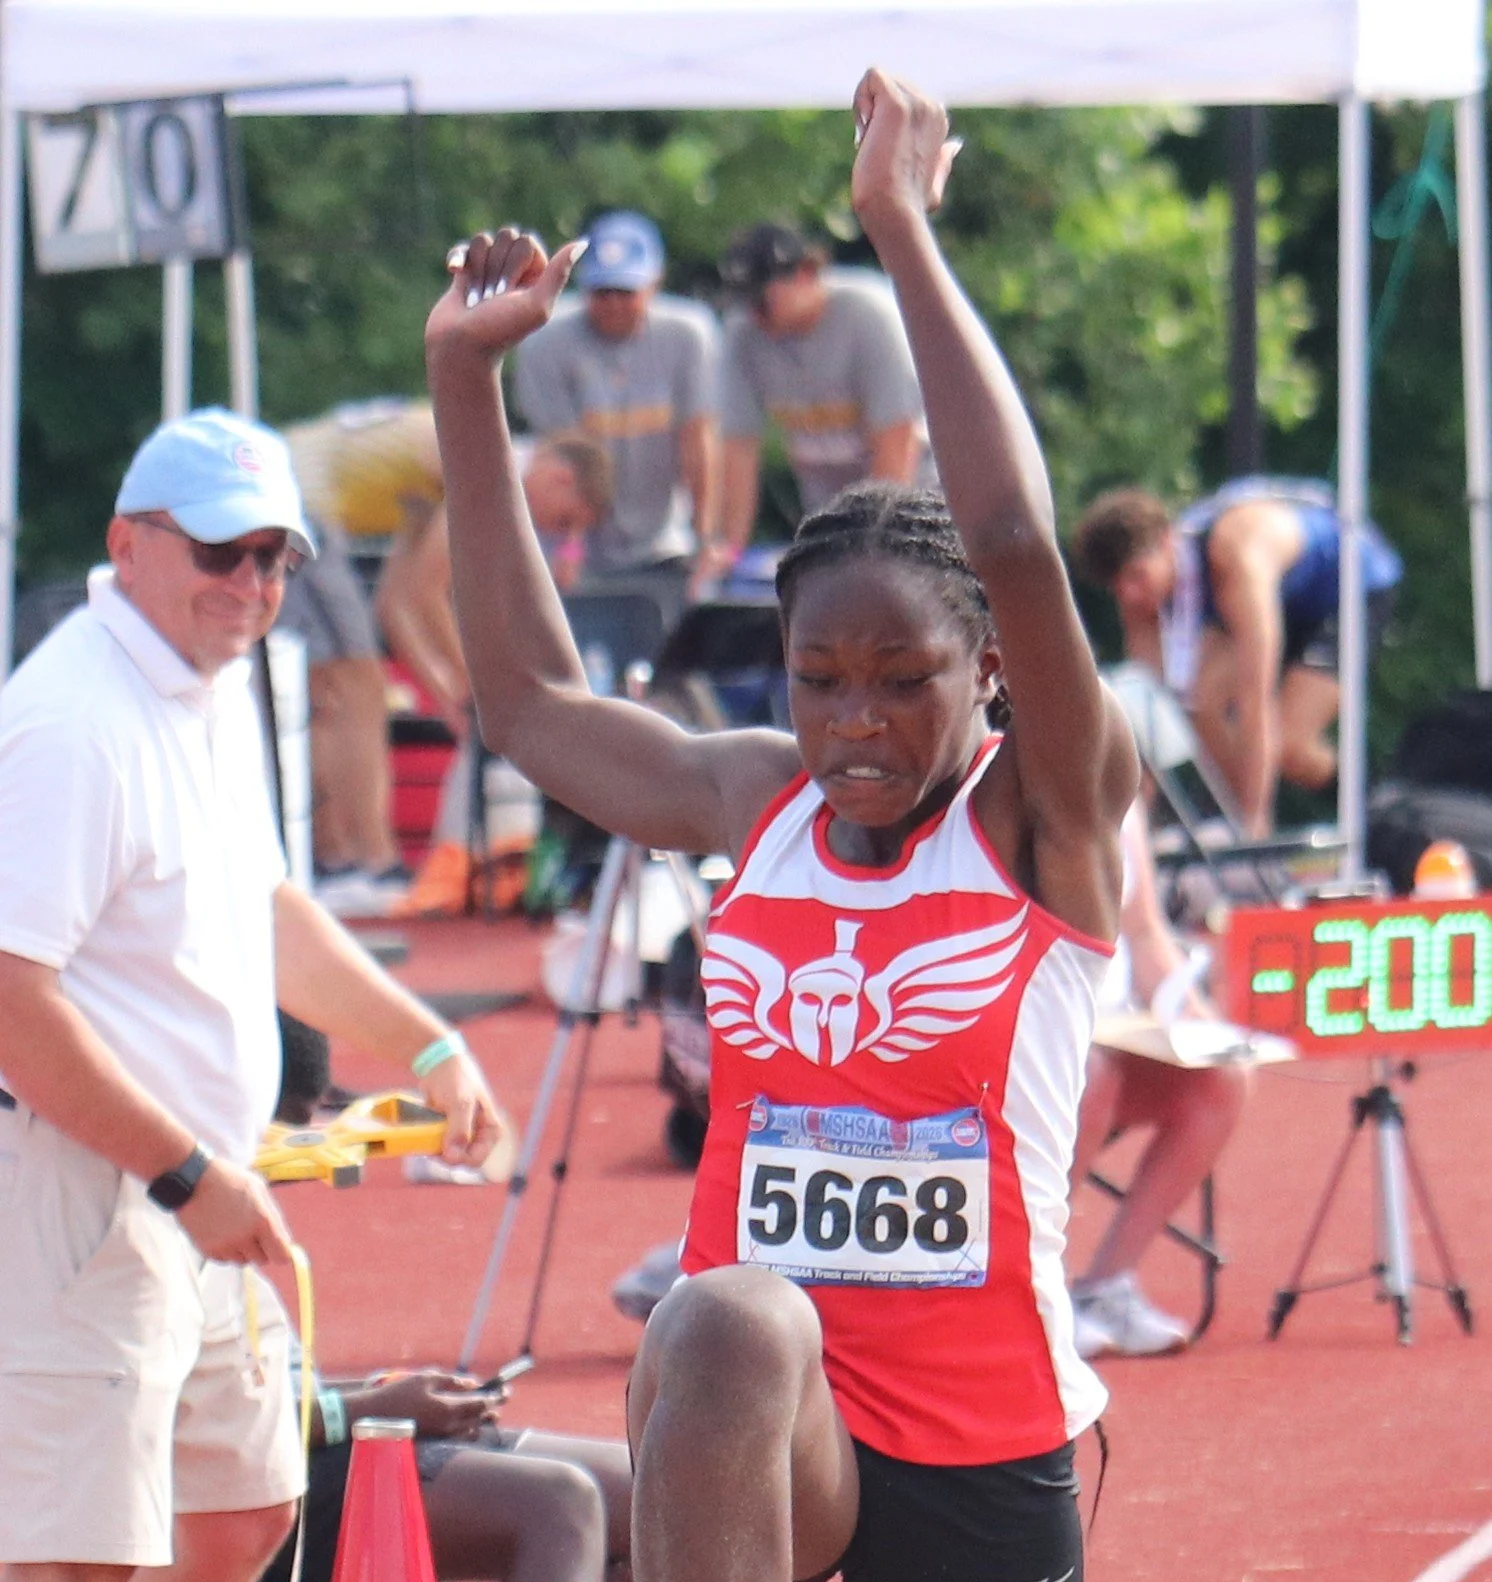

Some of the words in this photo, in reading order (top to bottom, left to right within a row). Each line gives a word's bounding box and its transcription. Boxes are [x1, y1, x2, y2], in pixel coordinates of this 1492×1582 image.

[41, 107, 197, 232] 70
[820, 1112, 890, 1141] MSHSAA
[747, 1163, 969, 1255] 5668
[814, 1269, 842, 1280] Track
[842, 1270, 864, 1281] and
[863, 1271, 889, 1282] Field
